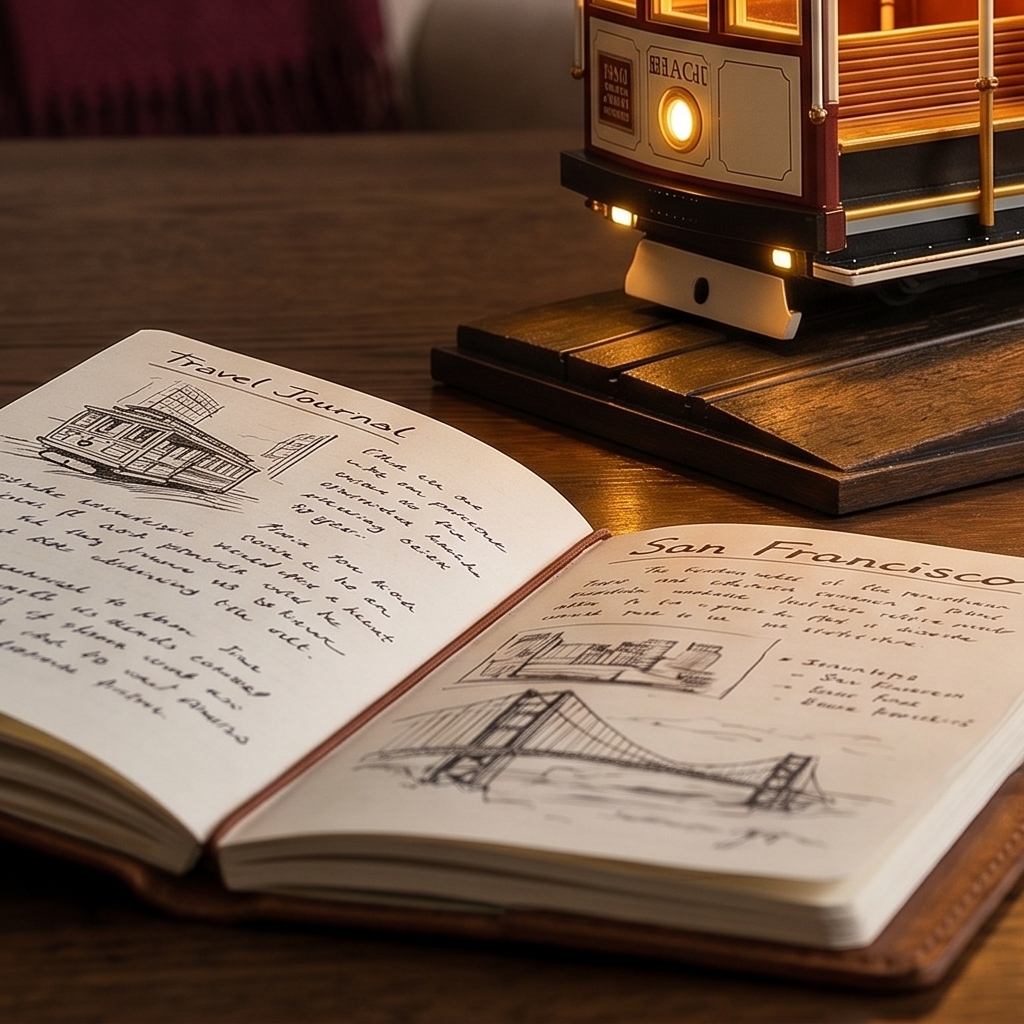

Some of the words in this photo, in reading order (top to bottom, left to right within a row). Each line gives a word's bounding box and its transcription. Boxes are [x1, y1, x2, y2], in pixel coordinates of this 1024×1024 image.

[167, 350, 272, 388] Travel
[273, 385, 416, 438] Journal
[629, 537, 725, 556] San
